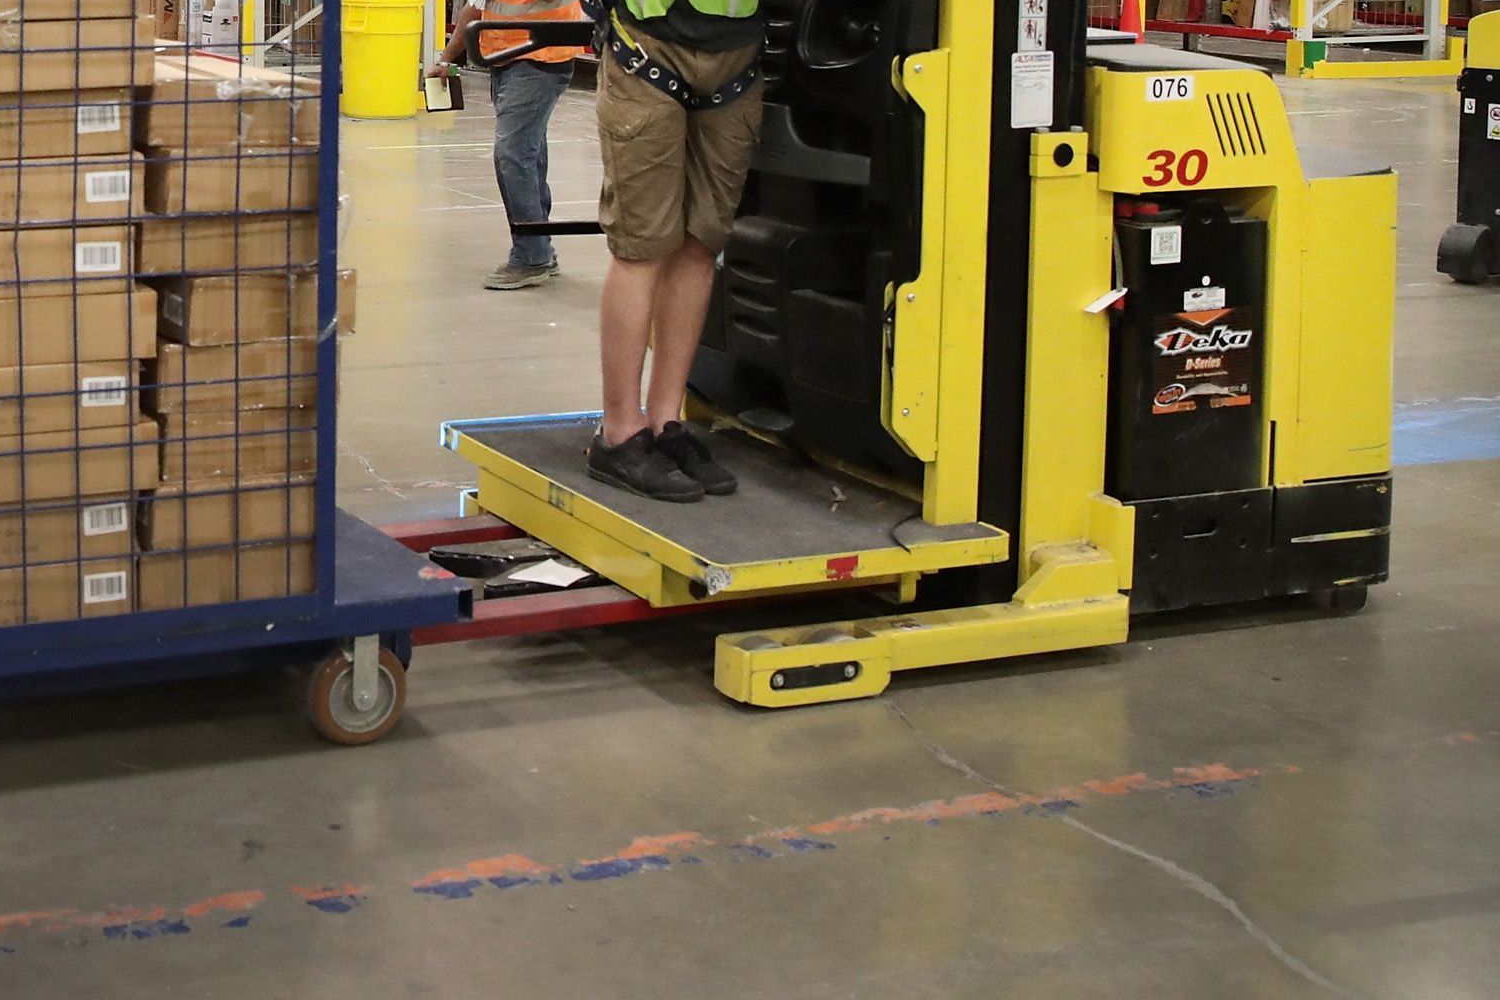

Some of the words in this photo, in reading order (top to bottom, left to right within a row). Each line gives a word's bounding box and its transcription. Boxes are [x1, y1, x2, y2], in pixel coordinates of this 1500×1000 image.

[1152, 77, 1188, 99] 076
[1141, 148, 1209, 187] 30
[1154, 325, 1253, 356] Deka
[1185, 356, 1222, 370] D-Series
